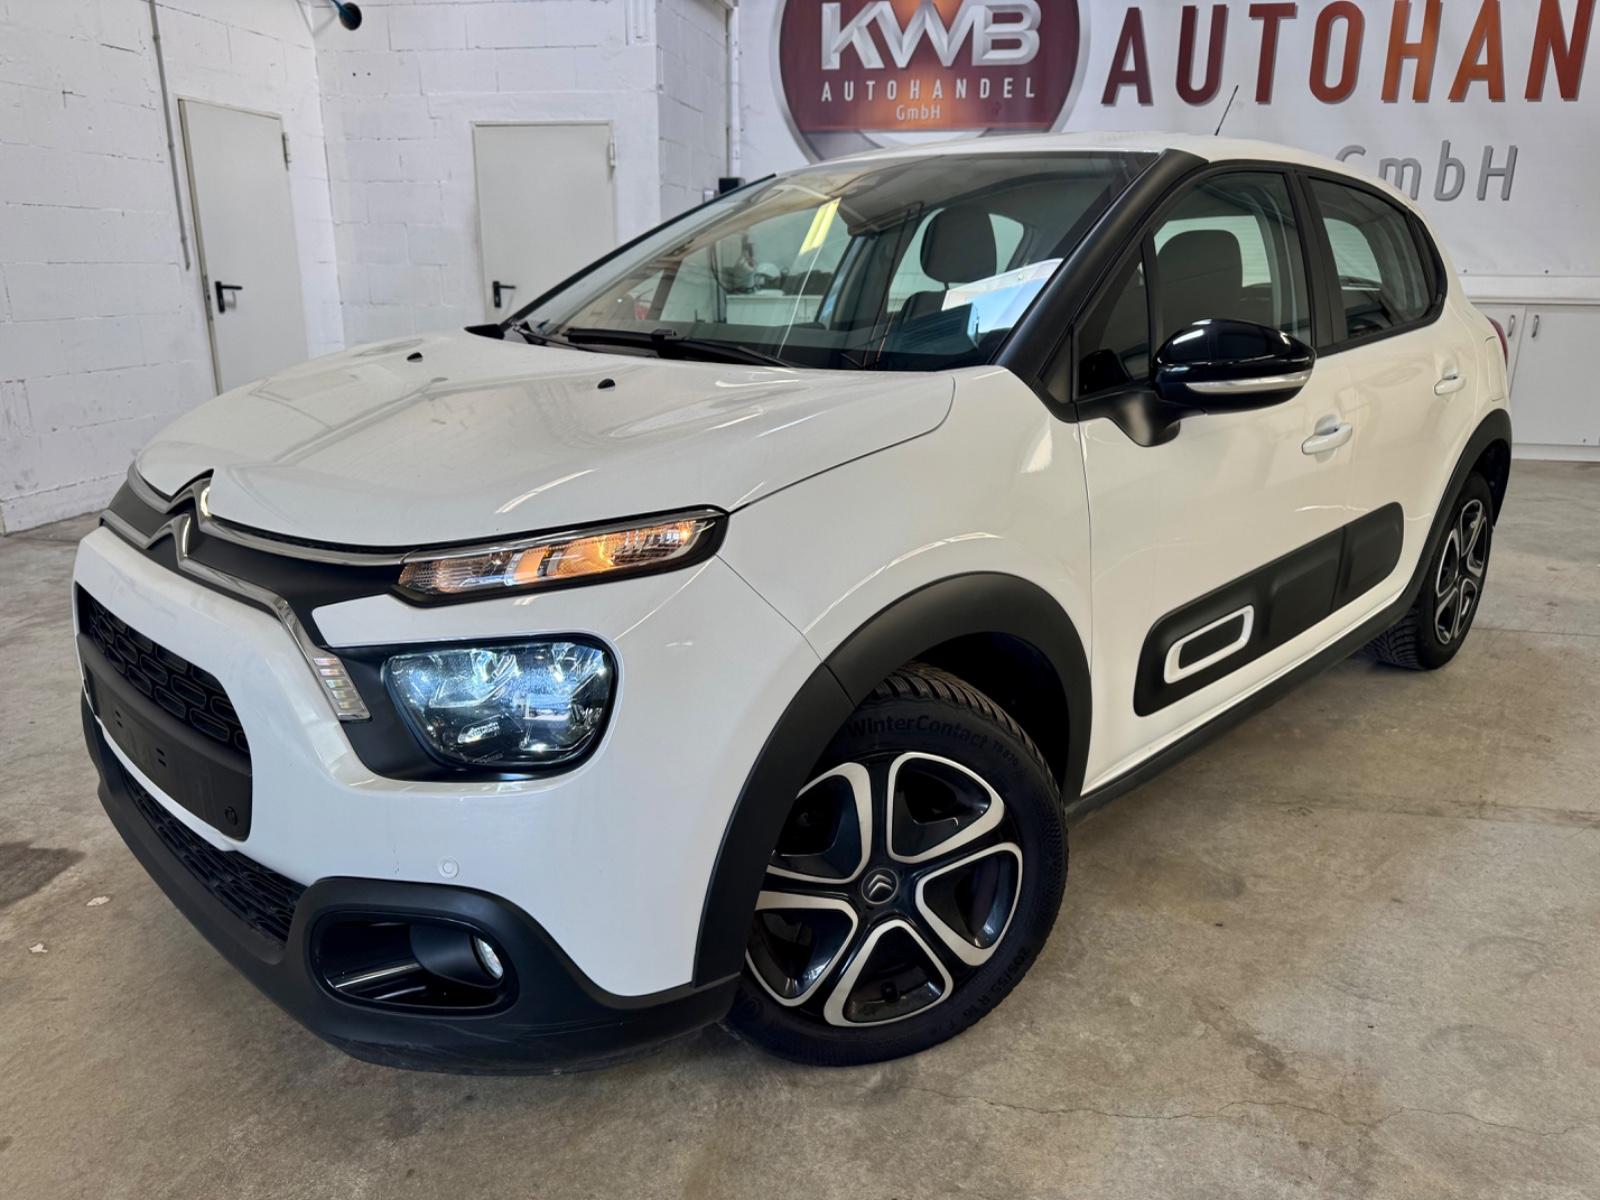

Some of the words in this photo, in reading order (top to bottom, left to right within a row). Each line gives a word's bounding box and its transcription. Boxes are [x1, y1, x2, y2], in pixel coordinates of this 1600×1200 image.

[821, 0, 1041, 70] KWB
[1100, 0, 1597, 106] AUTOHAN
[821, 77, 1035, 102] AUTOHANDEL
[896, 104, 941, 121] GmbH
[1335, 139, 1518, 201] mbH
[847, 715, 988, 749] WinterContact
